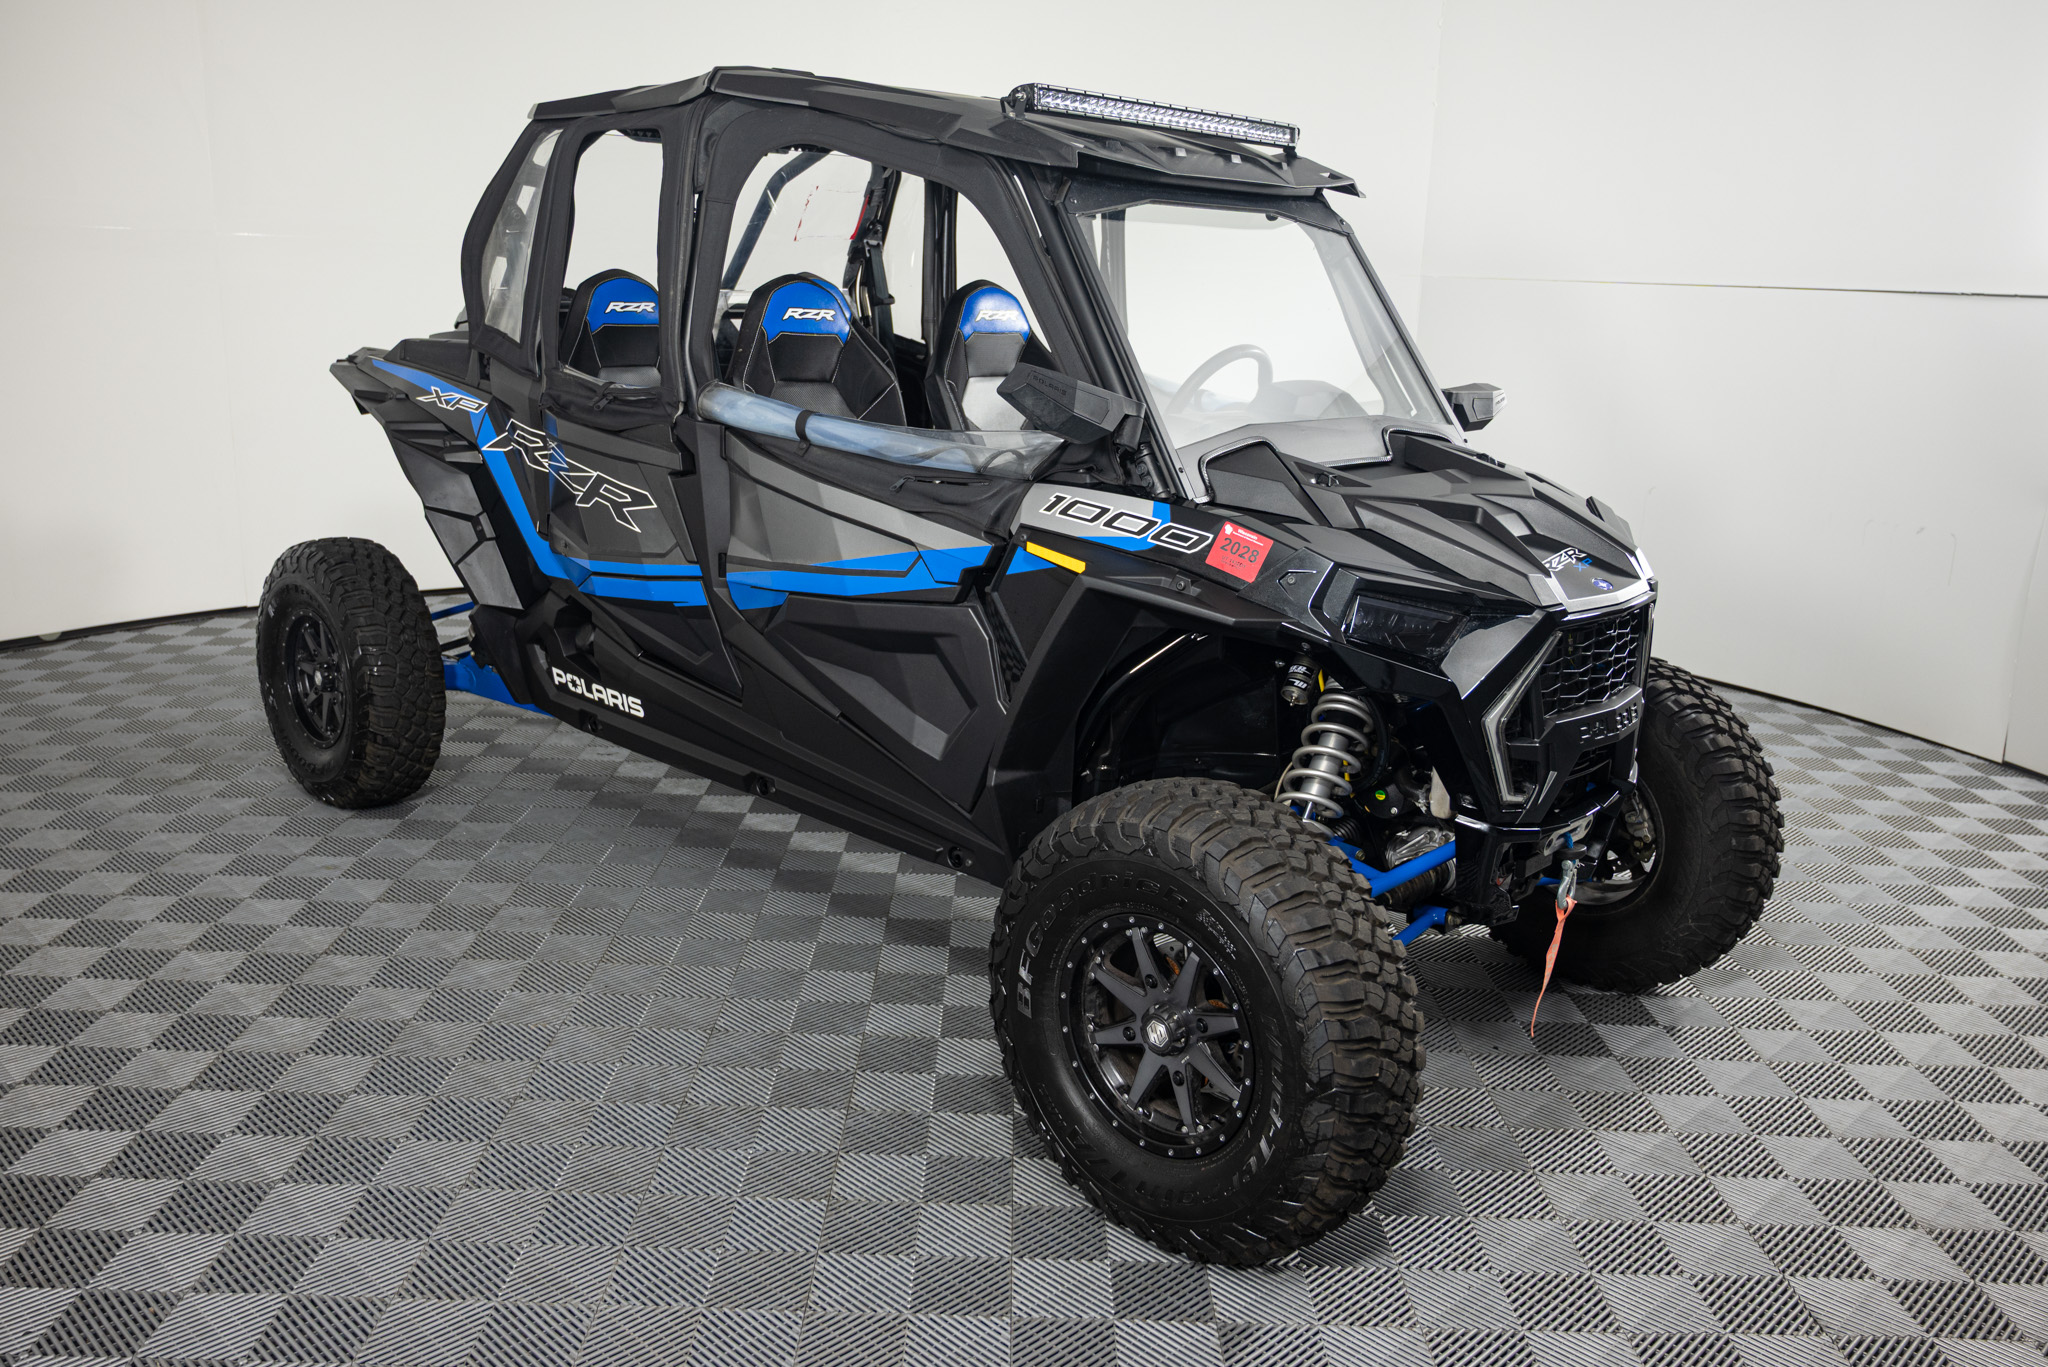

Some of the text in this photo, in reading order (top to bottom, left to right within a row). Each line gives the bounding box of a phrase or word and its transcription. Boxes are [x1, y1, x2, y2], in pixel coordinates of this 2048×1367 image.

[604, 301, 656, 314] RZR
[781, 307, 836, 321] RZR
[974, 309, 1019, 322] RZR
[416, 386, 488, 413] XP
[481, 418, 657, 533] RZR
[1039, 492, 1214, 554] 1000
[1219, 537, 1259, 563] 2028
[1573, 558, 1592, 572] XP
[551, 666, 645, 718] POLARIS
